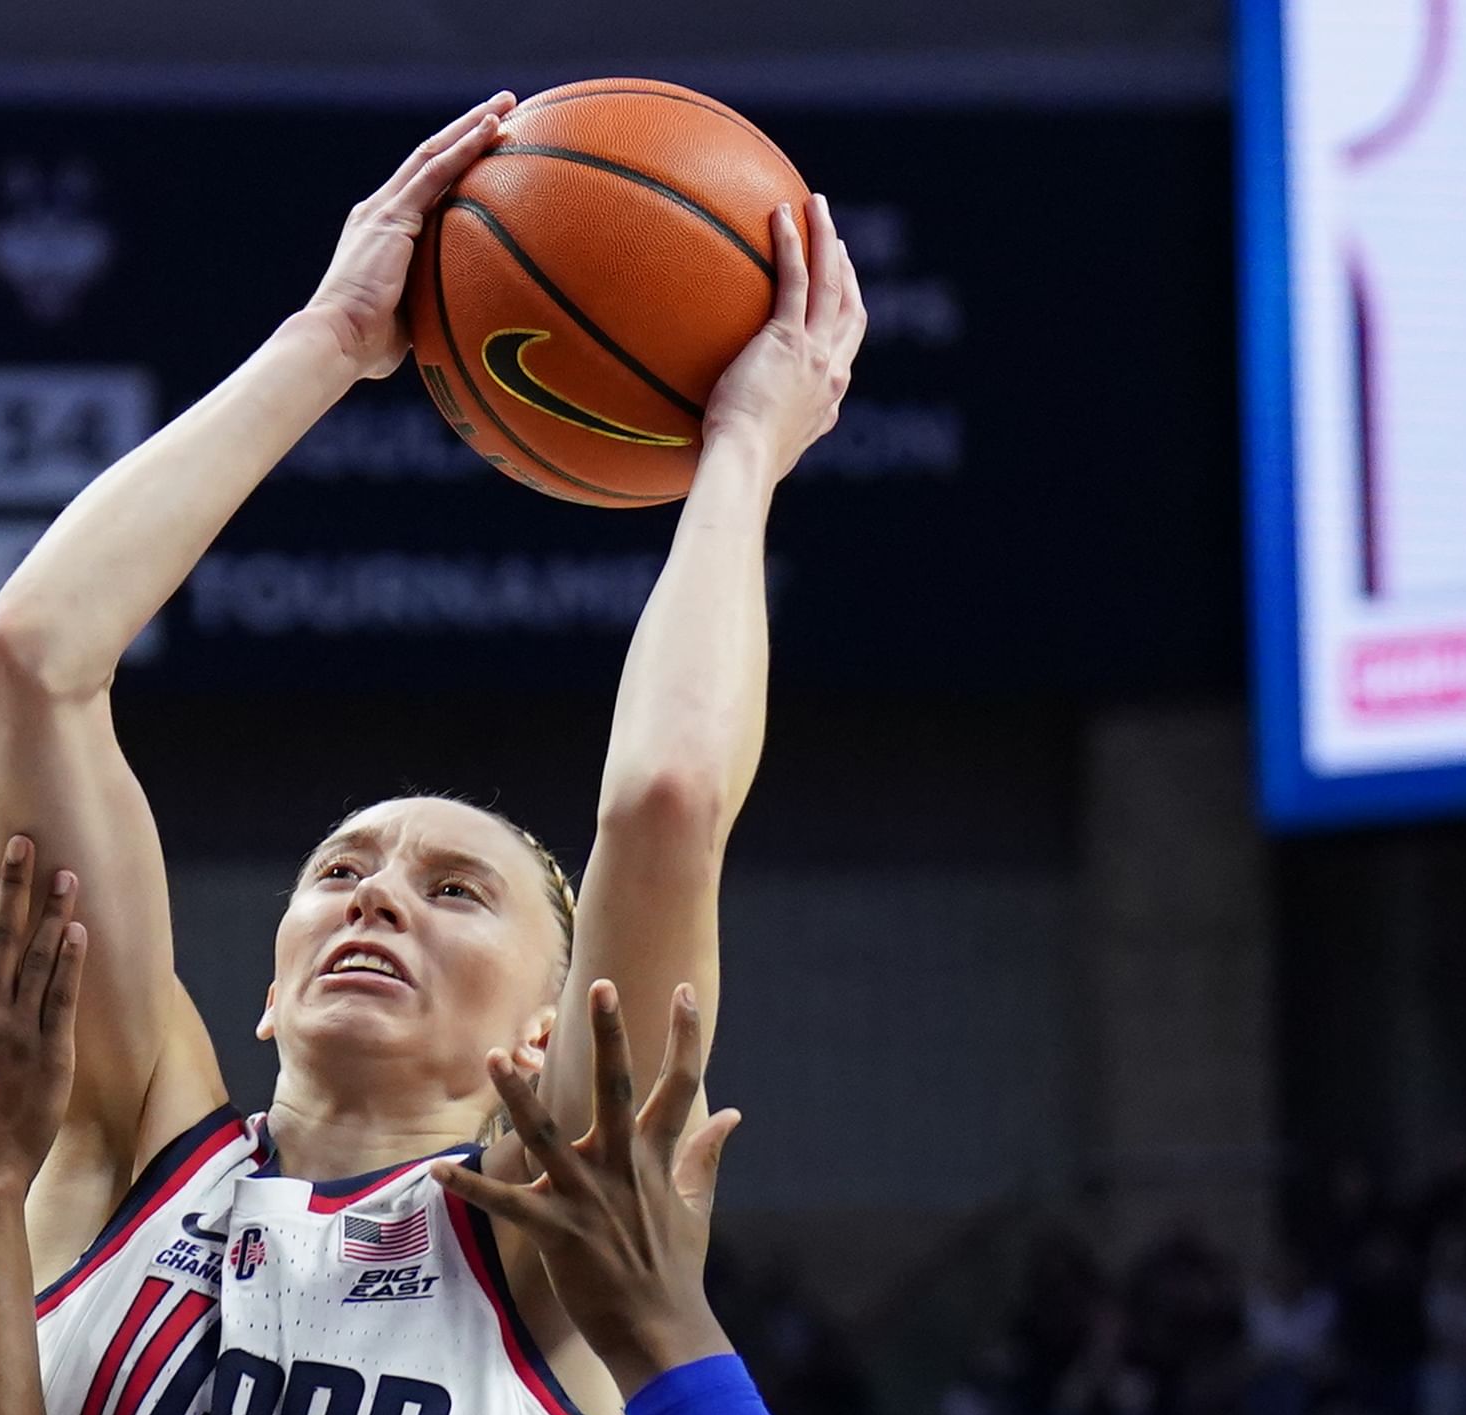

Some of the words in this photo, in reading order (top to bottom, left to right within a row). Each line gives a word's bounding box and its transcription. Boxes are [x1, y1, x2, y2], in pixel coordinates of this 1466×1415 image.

[171, 1239, 203, 1256] BE
[361, 1265, 422, 1283] BIG
[348, 1276, 441, 1297] EAST
